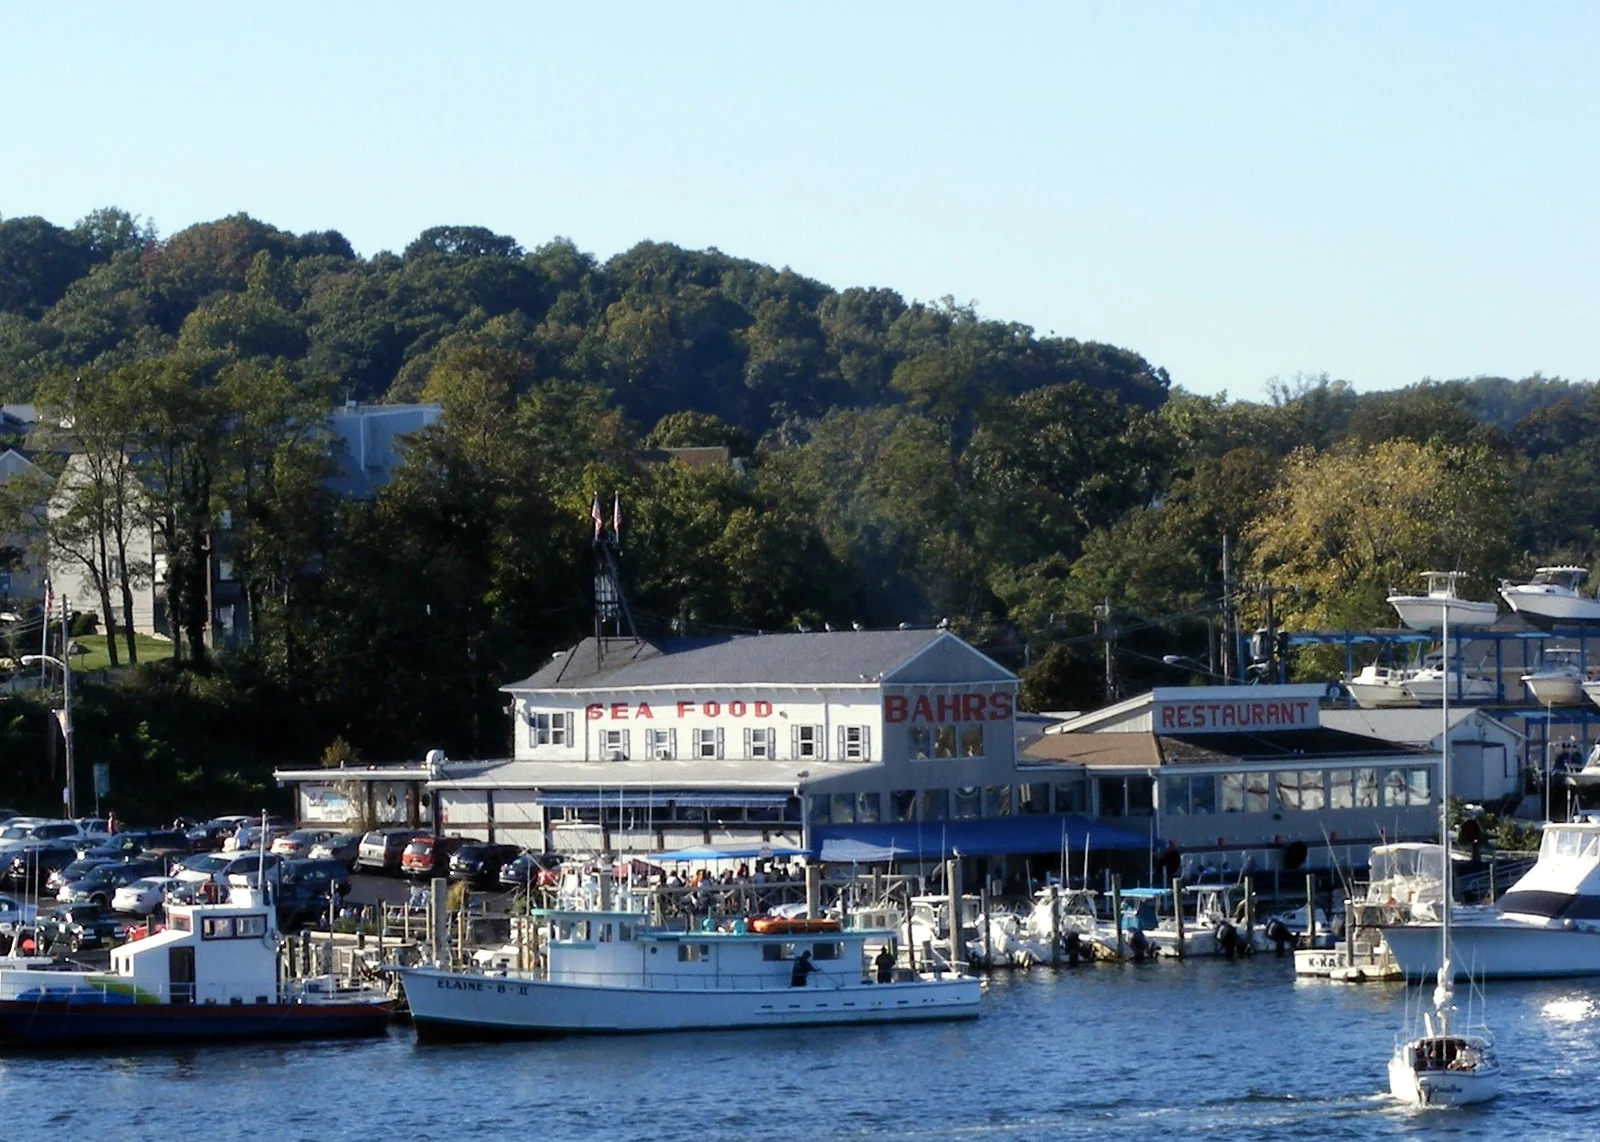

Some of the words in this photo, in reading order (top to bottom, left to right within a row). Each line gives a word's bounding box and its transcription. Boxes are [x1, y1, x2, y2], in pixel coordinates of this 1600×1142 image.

[585, 702, 654, 720] SEA
[676, 700, 773, 718] FOOD
[884, 691, 1013, 723] BAHRS
[1161, 701, 1309, 729] RESTAURANT
[437, 979, 484, 992] ELAINE
